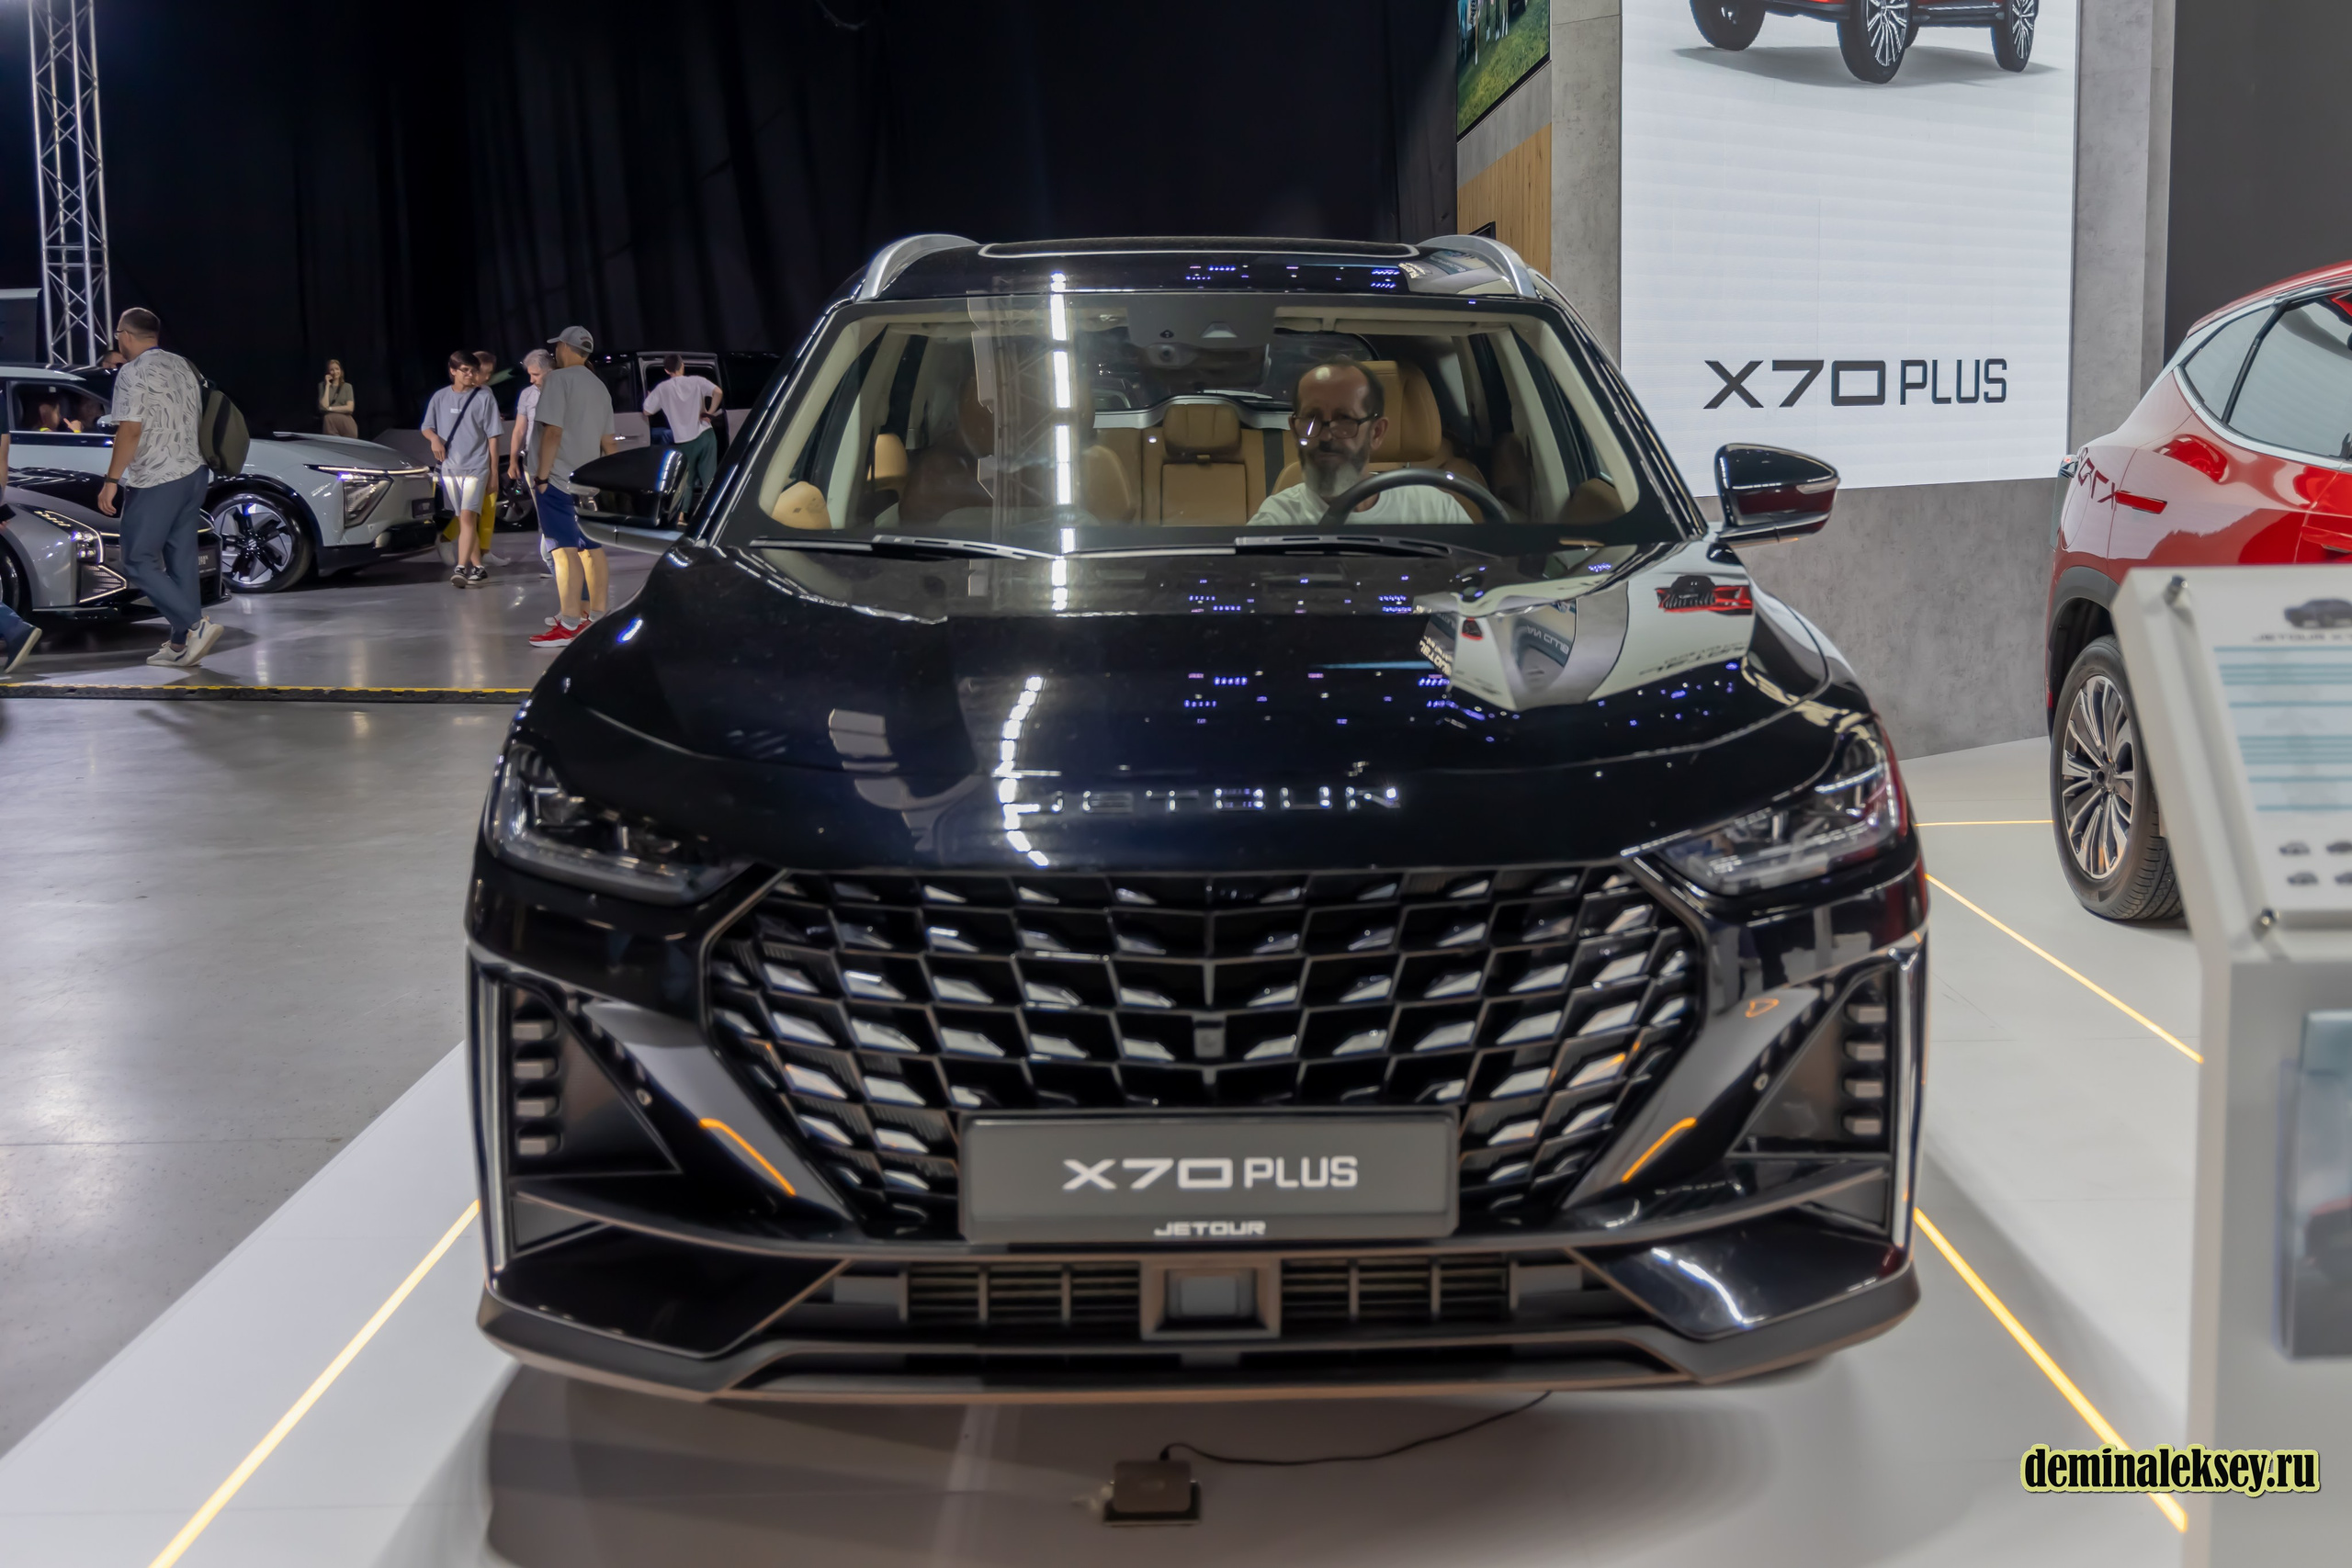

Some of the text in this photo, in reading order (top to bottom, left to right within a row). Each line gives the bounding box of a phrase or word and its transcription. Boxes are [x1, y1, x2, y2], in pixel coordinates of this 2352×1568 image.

[1702, 357, 2007, 410] X70 PLUS
[1061, 1156, 1359, 1190] X70 PLUS
[1153, 1220, 1267, 1236] JETOUR
